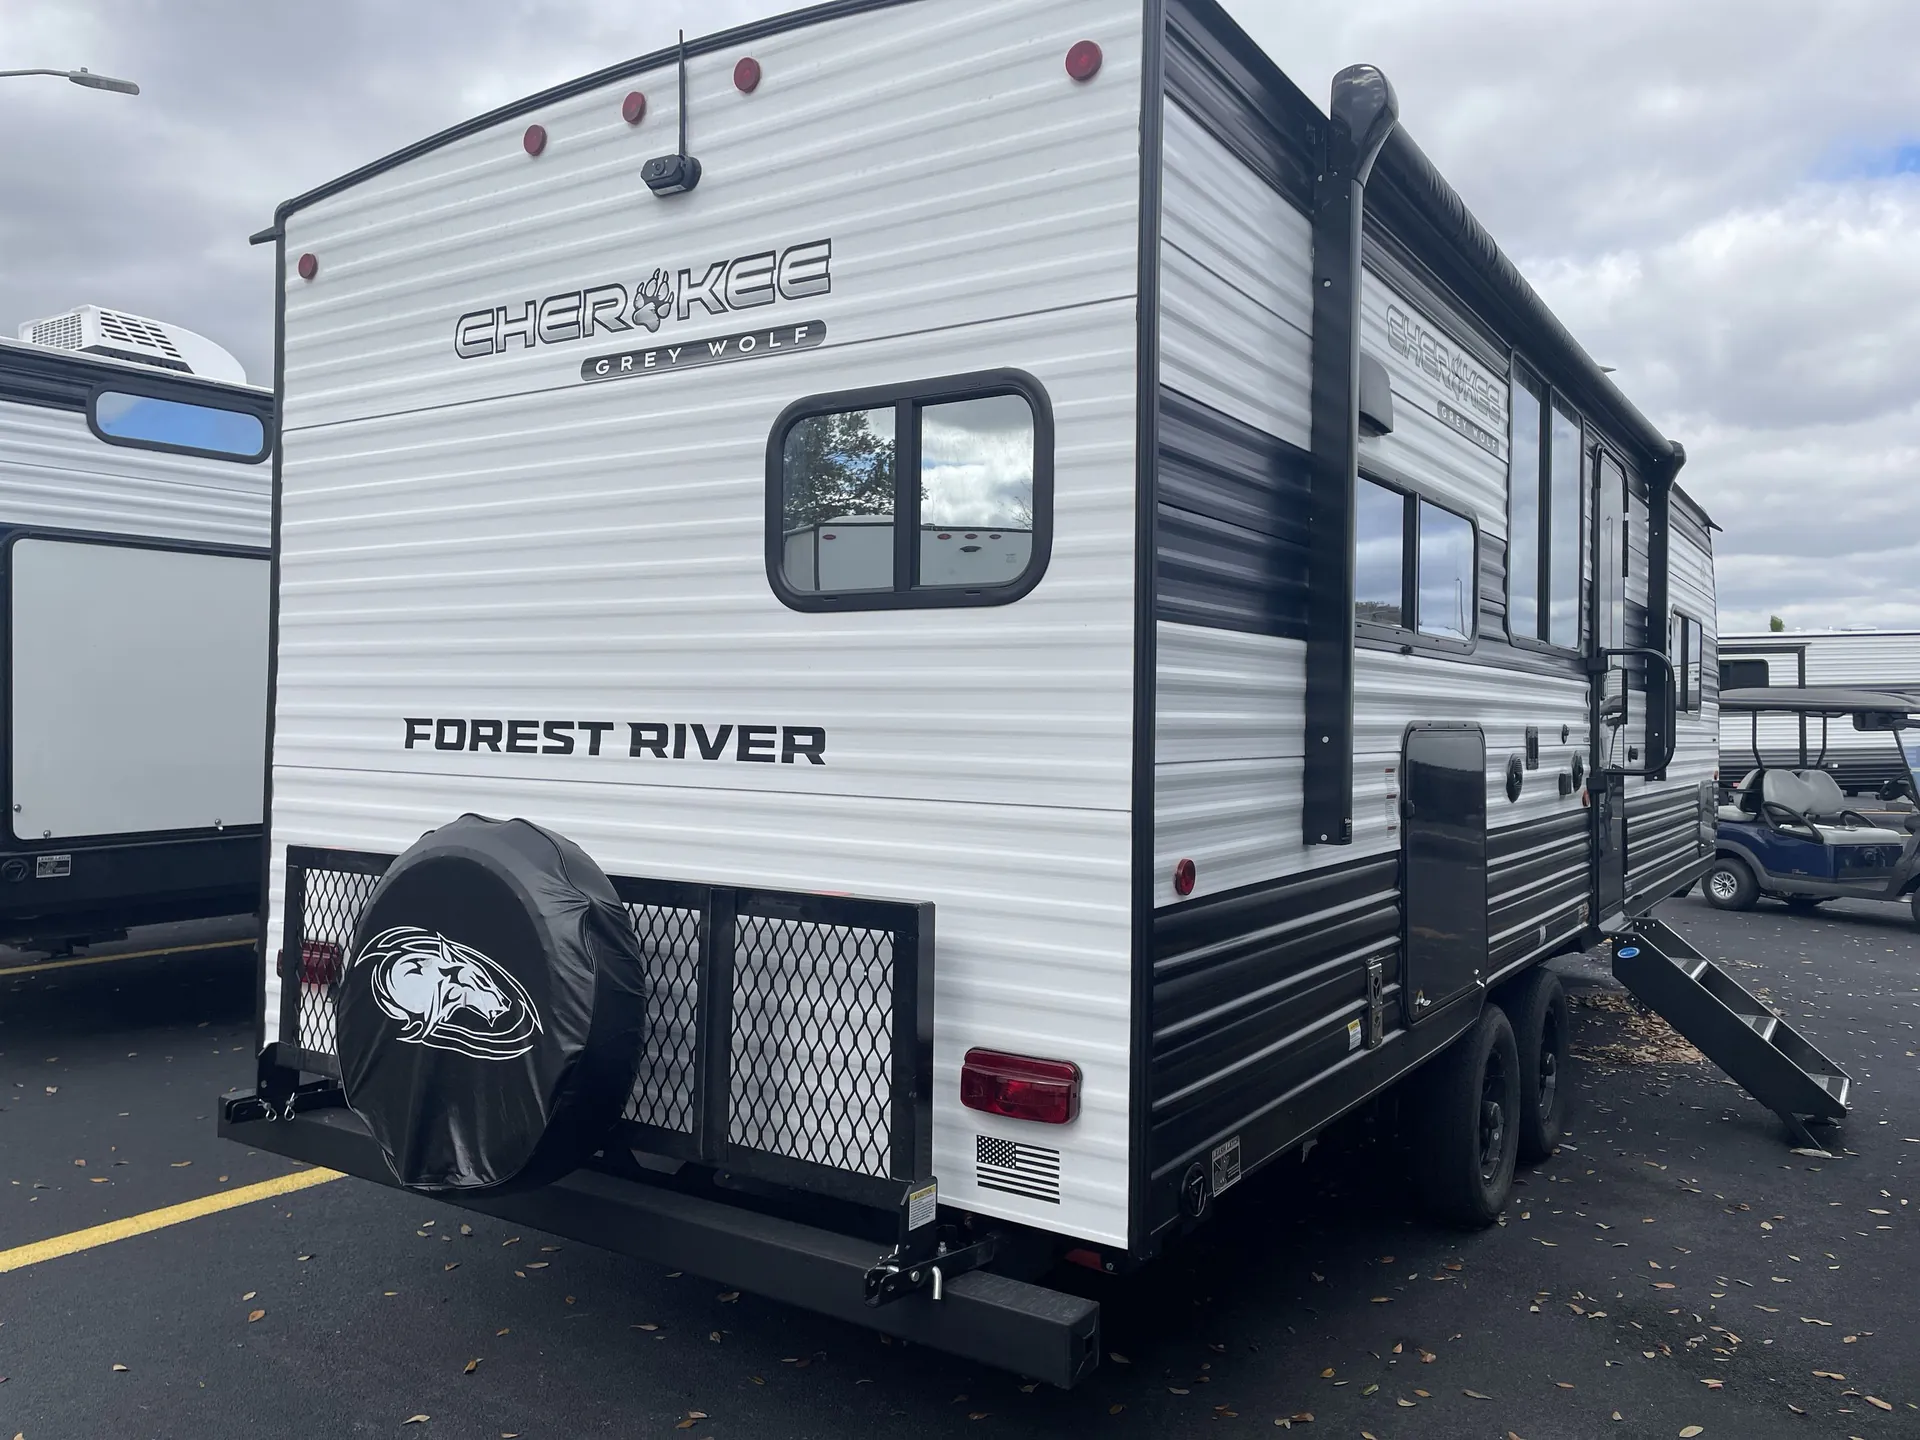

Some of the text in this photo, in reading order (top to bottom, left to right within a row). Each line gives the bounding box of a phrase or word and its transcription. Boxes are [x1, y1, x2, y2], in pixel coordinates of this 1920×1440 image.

[455, 238, 832, 359] CHEROKEE
[594, 325, 809, 376] GREY WOLF
[1441, 406, 1496, 449] GREY WOLF
[403, 717, 827, 765] FOREST RIVER
